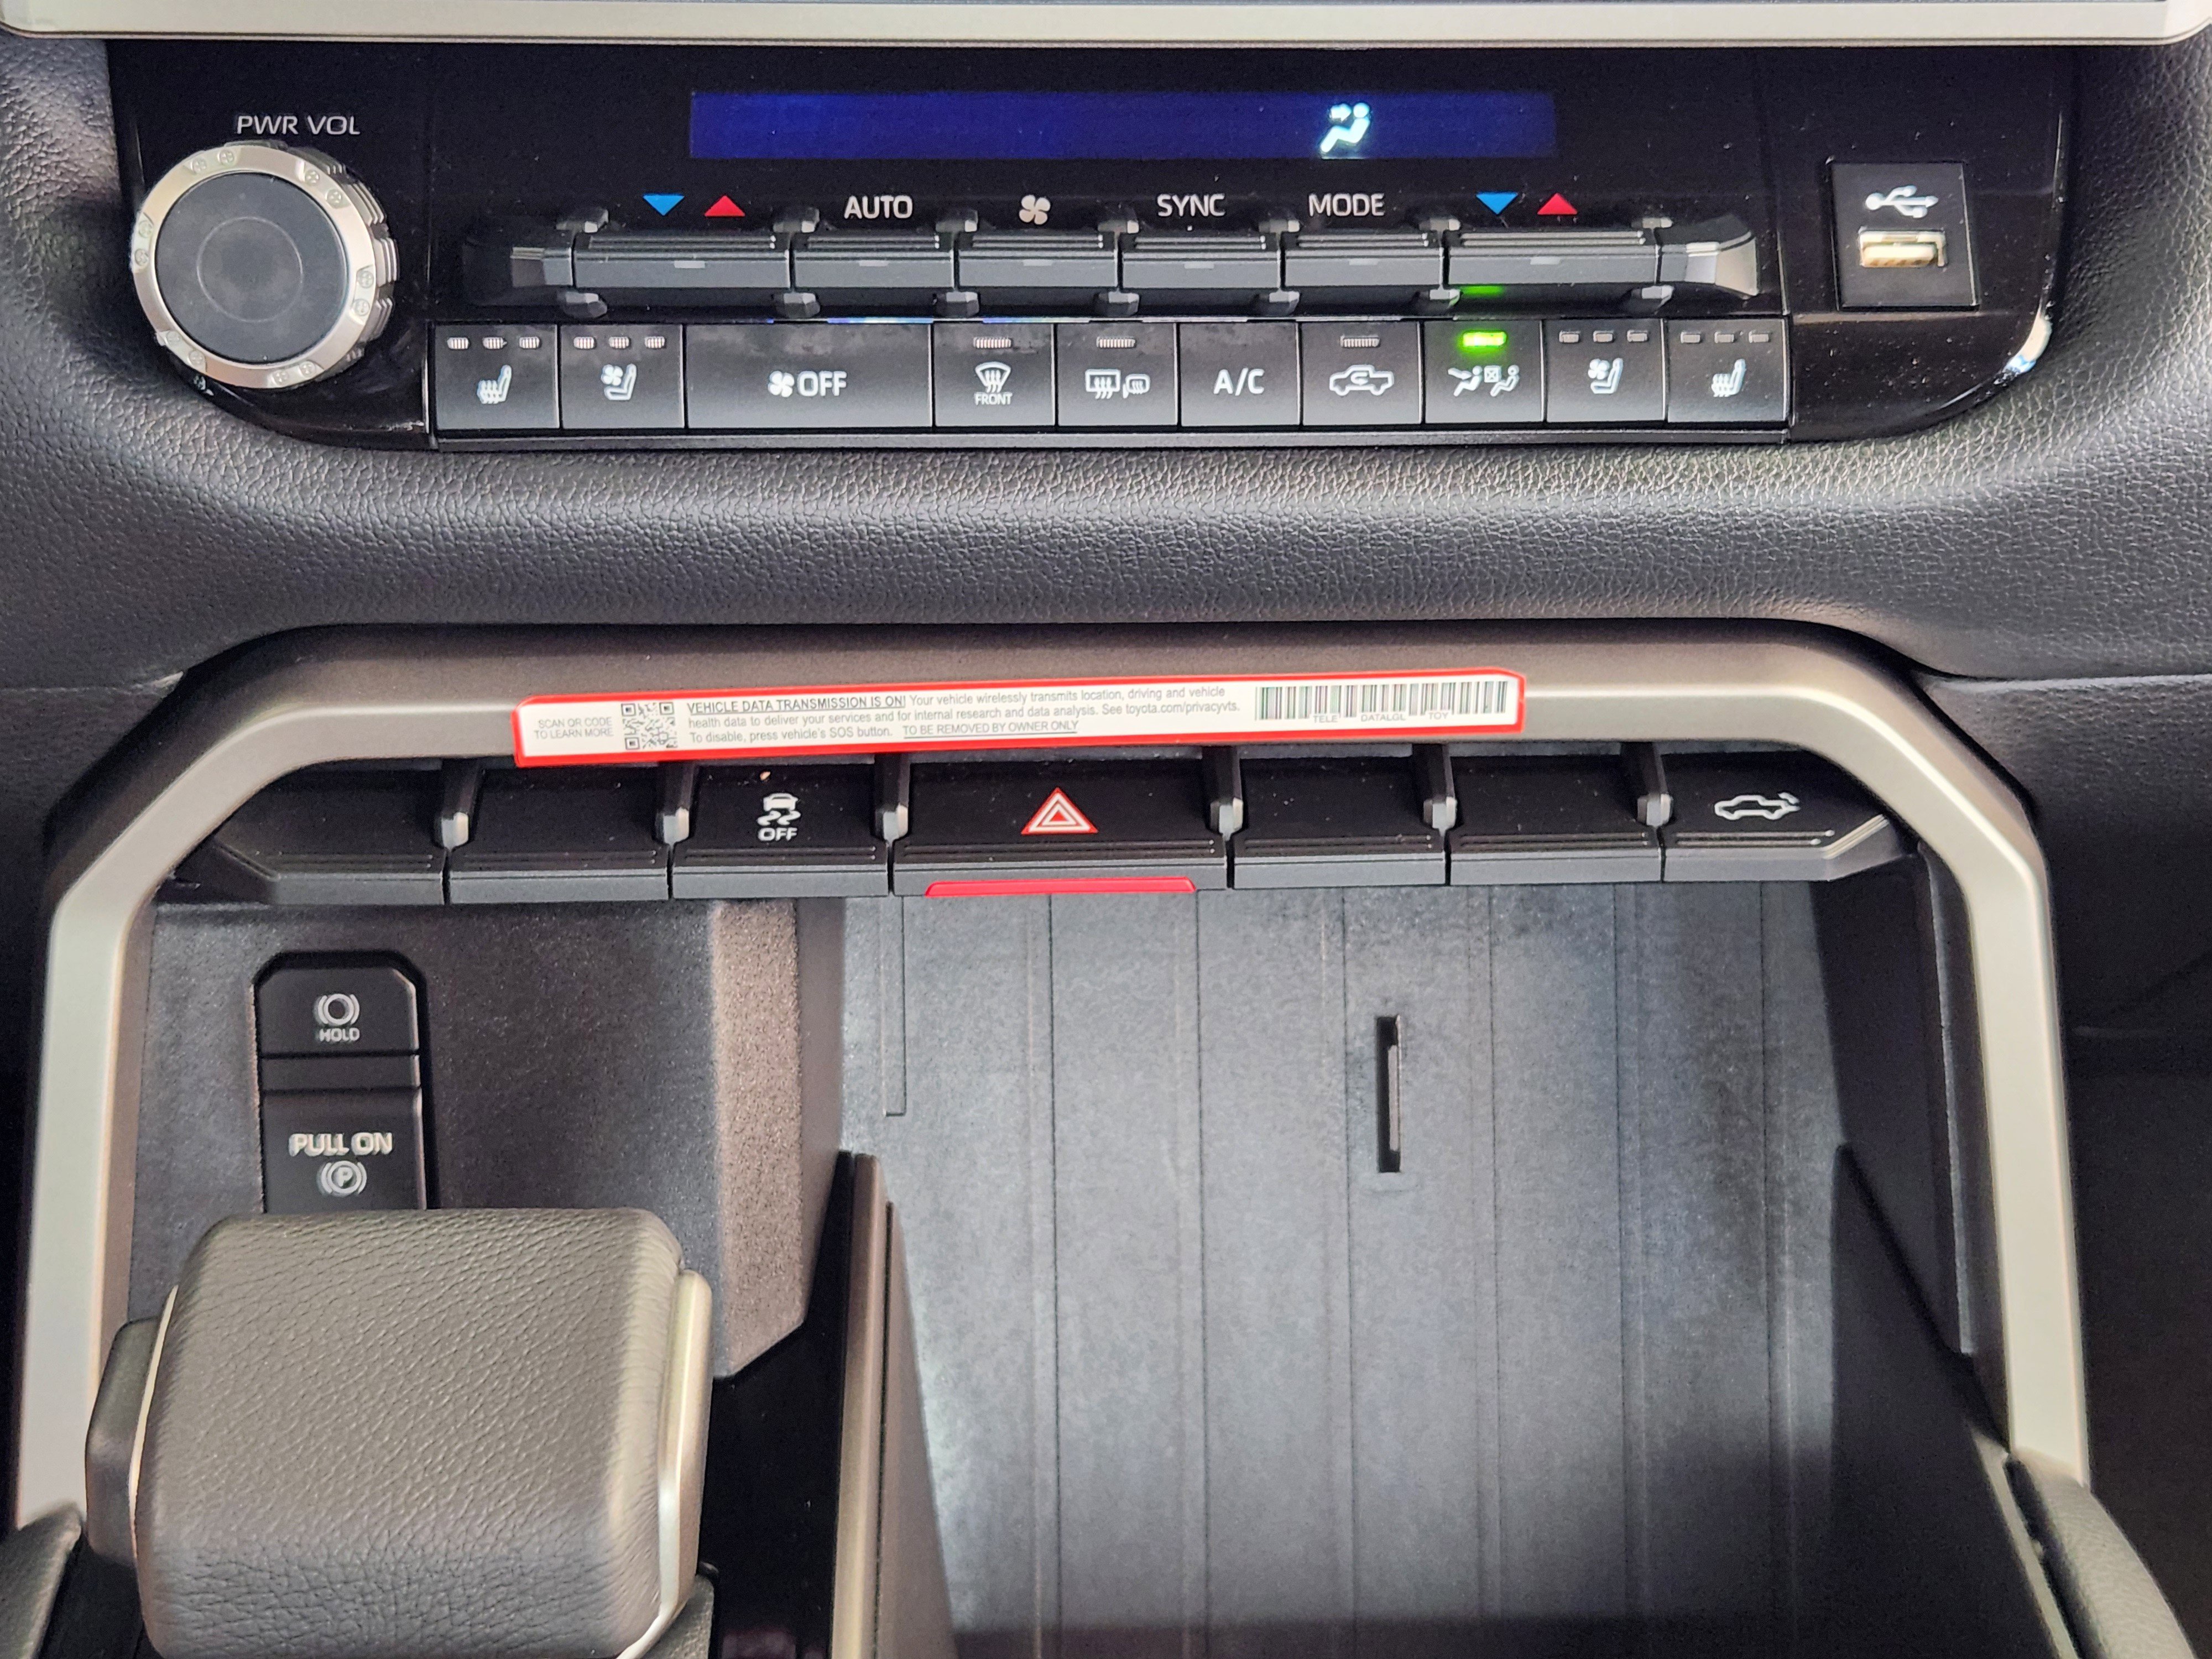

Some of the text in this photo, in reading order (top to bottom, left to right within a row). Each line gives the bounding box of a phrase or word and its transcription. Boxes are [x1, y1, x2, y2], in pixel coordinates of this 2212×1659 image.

[237, 115, 361, 135] PWR VOL
[844, 195, 914, 220] AUTO
[1156, 193, 1226, 217] SYNC
[1308, 193, 1386, 217] MODE
[797, 371, 847, 398] OFF
[1213, 368, 1265, 395] A/C
[974, 393, 1013, 406] FRONT
[687, 701, 739, 713] VEHICLE
[742, 700, 774, 712] DATA
[776, 696, 867, 711] TRANSMISSION
[871, 696, 881, 707] IS
[909, 695, 933, 706] Your
[937, 693, 973, 705] vehicle
[977, 692, 1027, 705] wirelessly
[1030, 690, 1078, 702] transmits
[1081, 689, 1125, 701] location,
[1128, 687, 1162, 701] driving
[1166, 687, 1185, 698] and
[1189, 686, 1225, 697] vehicle
[538, 718, 565, 729] SCAN
[585, 716, 612, 727] CODE
[688, 701, 1240, 728] health data to deliver your services and for internal research and data analysis. See toyota.com/privacyvts.
[1313, 714, 1338, 723] TELE
[1428, 711, 1449, 720] TOY
[534, 727, 614, 739] TO LEARN MORE
[690, 720, 1079, 743] To disable, press vehicle's SOS button. TO BE REMOVED BY OWNER ONLY
[757, 827, 798, 842] OFF
[318, 1027, 361, 1042] HOLD
[289, 1131, 393, 1157] PULL ON
